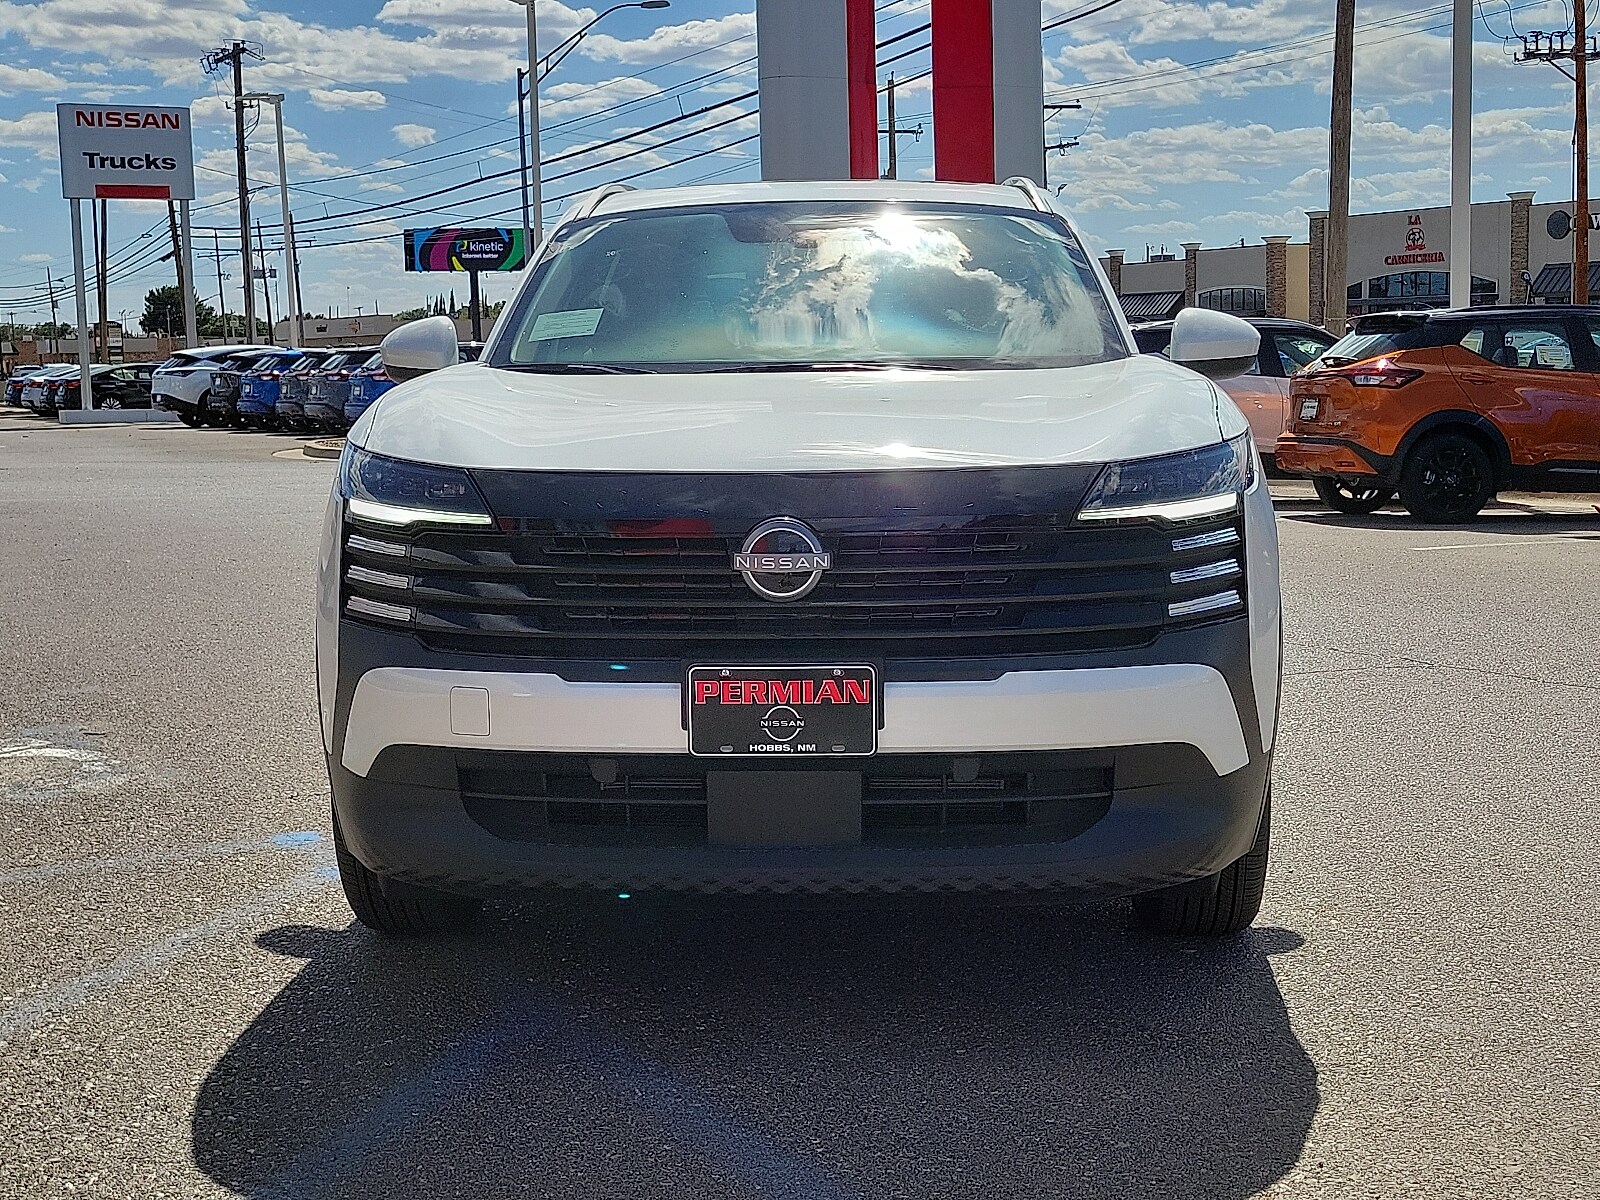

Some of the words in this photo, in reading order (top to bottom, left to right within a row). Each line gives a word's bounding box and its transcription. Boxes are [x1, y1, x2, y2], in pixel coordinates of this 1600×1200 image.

[75, 110, 180, 129] NISSAN
[82, 152, 177, 171] Trucks
[1407, 214, 1422, 225] LA
[469, 241, 504, 252] kinetic
[735, 555, 829, 569] NISSAN
[694, 680, 870, 705] PERMIAN
[760, 719, 805, 728] NISSAN
[749, 743, 793, 754] HOBBS,
[797, 743, 816, 753] NM
